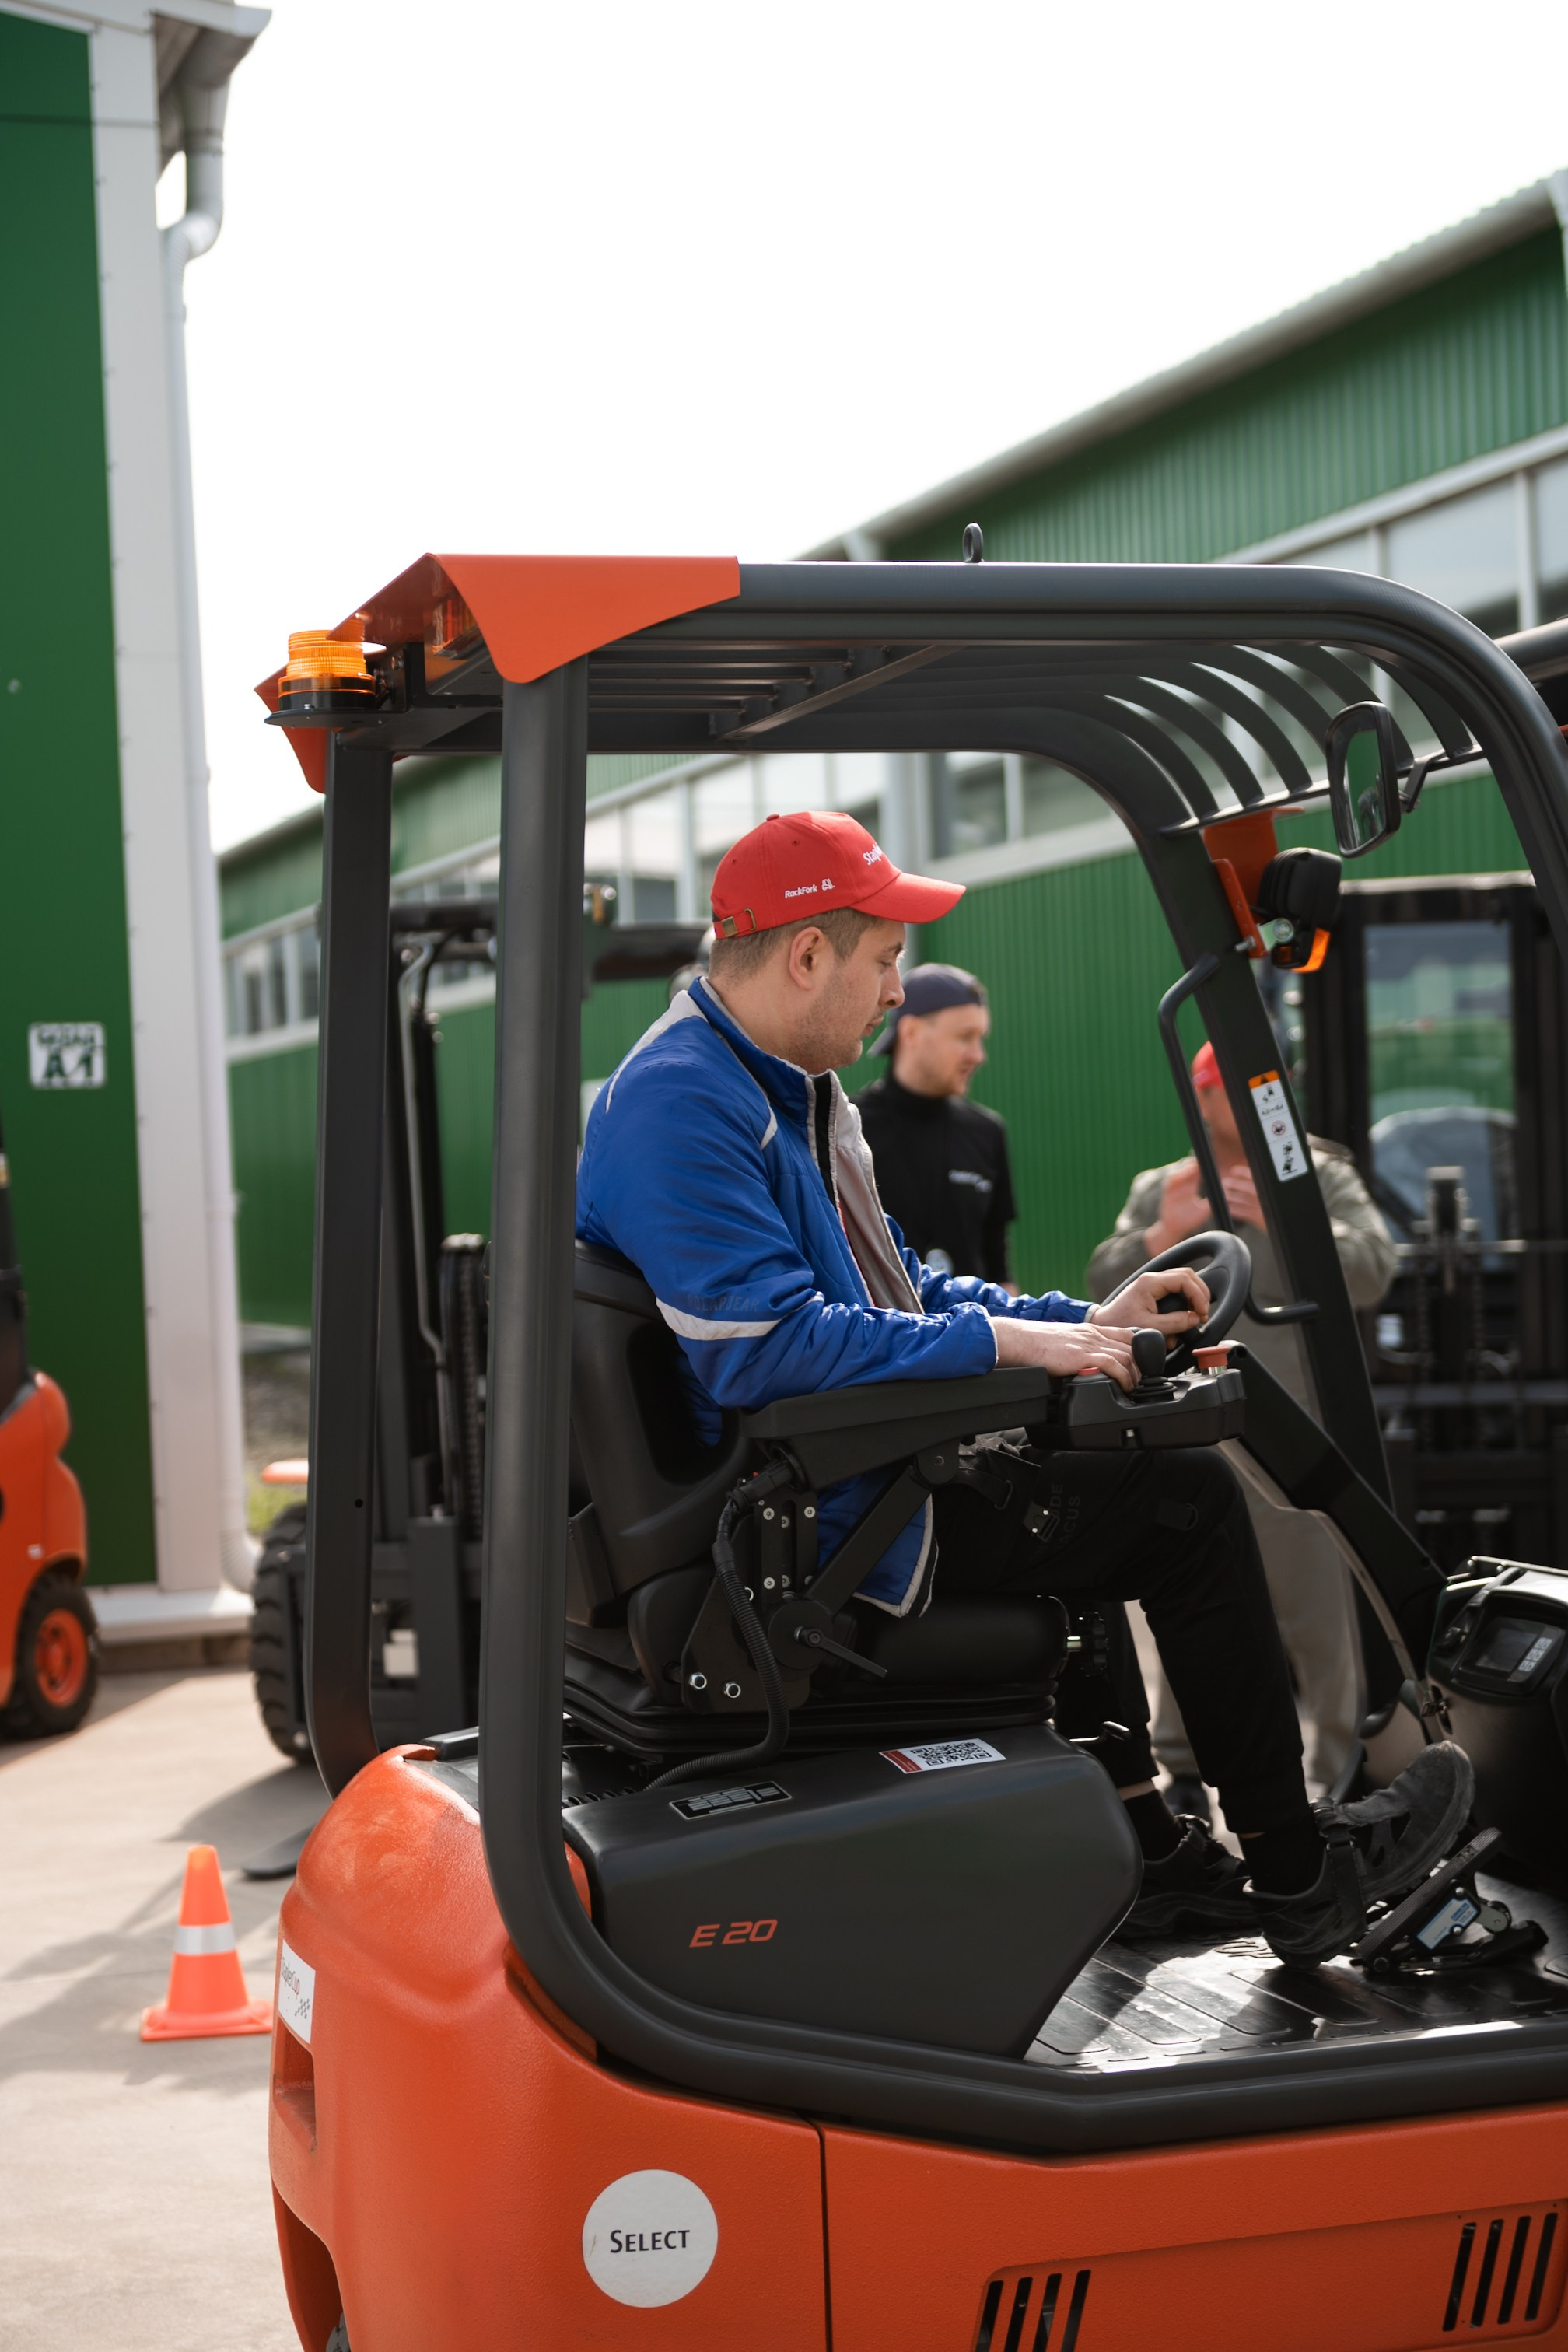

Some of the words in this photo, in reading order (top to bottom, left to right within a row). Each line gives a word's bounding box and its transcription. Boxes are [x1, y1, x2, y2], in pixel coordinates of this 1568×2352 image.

[785, 884, 817, 898] RackFork
[689, 1923, 721, 1948] E
[722, 1919, 778, 1944] 20
